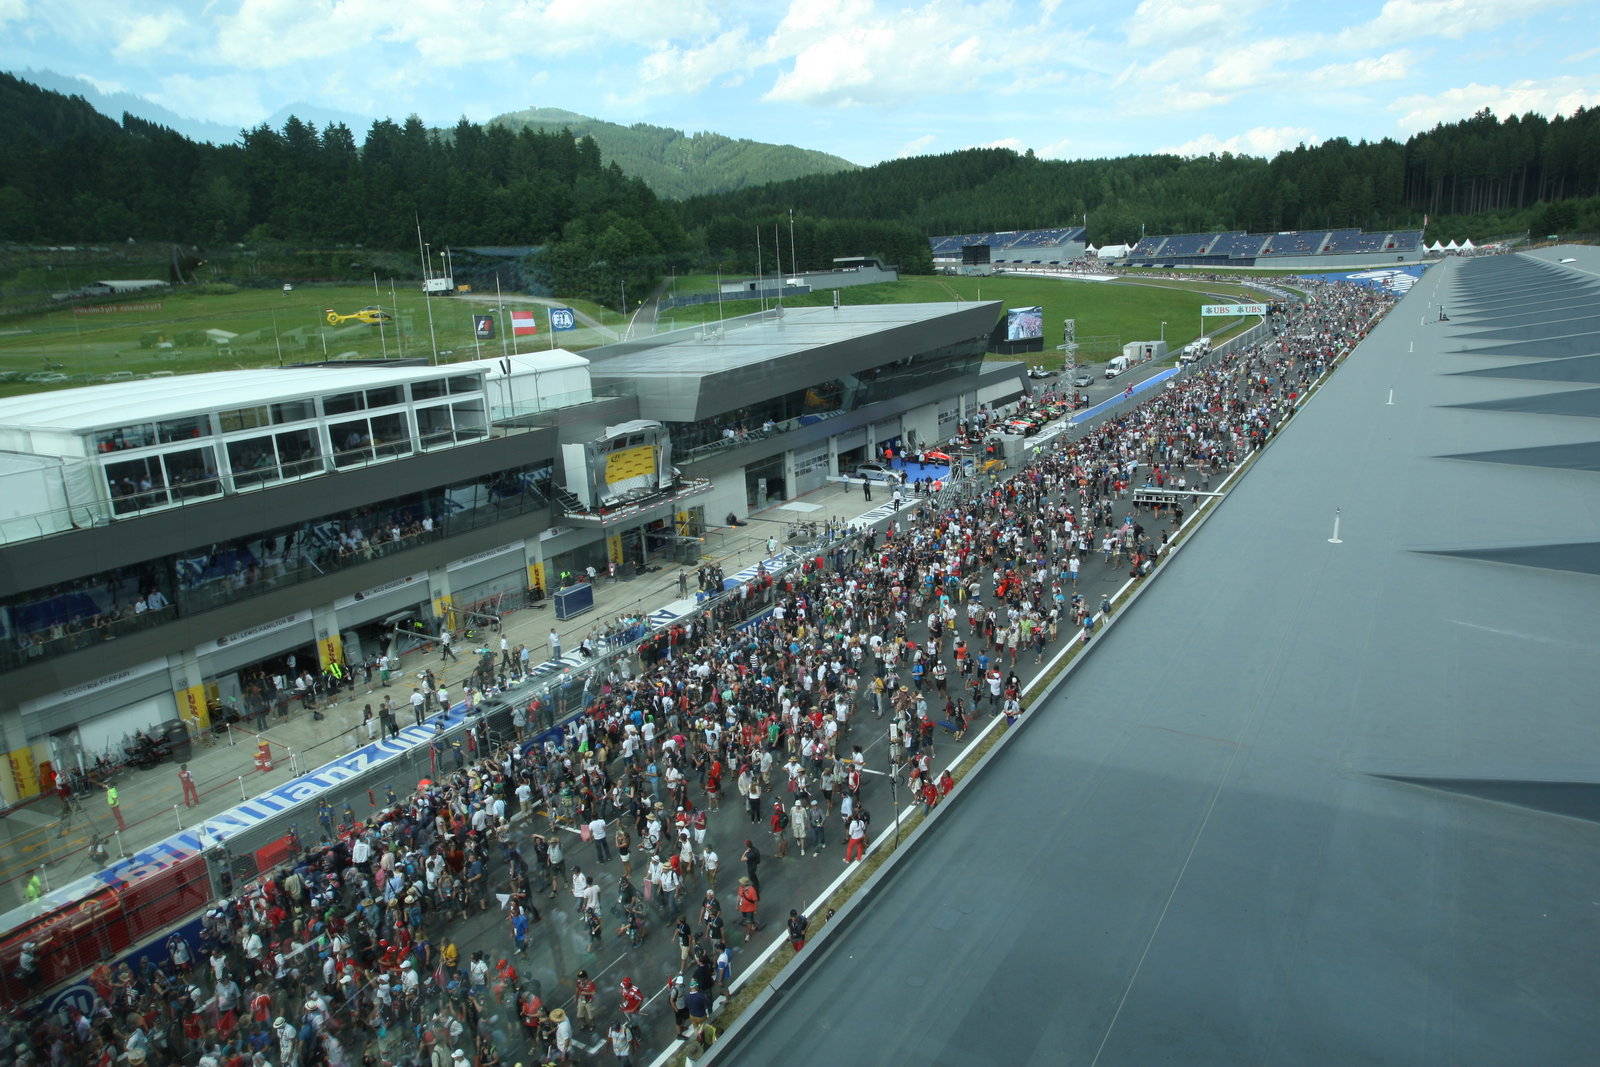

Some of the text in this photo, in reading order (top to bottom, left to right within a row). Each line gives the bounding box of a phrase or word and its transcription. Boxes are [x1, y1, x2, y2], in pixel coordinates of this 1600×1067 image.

[1213, 306, 1230, 314] UBS
[1245, 305, 1262, 313] UBS
[552, 313, 573, 327] FIA
[240, 628, 258, 639] LEWIS
[258, 617, 287, 633] HAMILTON
[63, 681, 100, 698] SCUDERIA
[199, 750, 384, 848] Allianz
